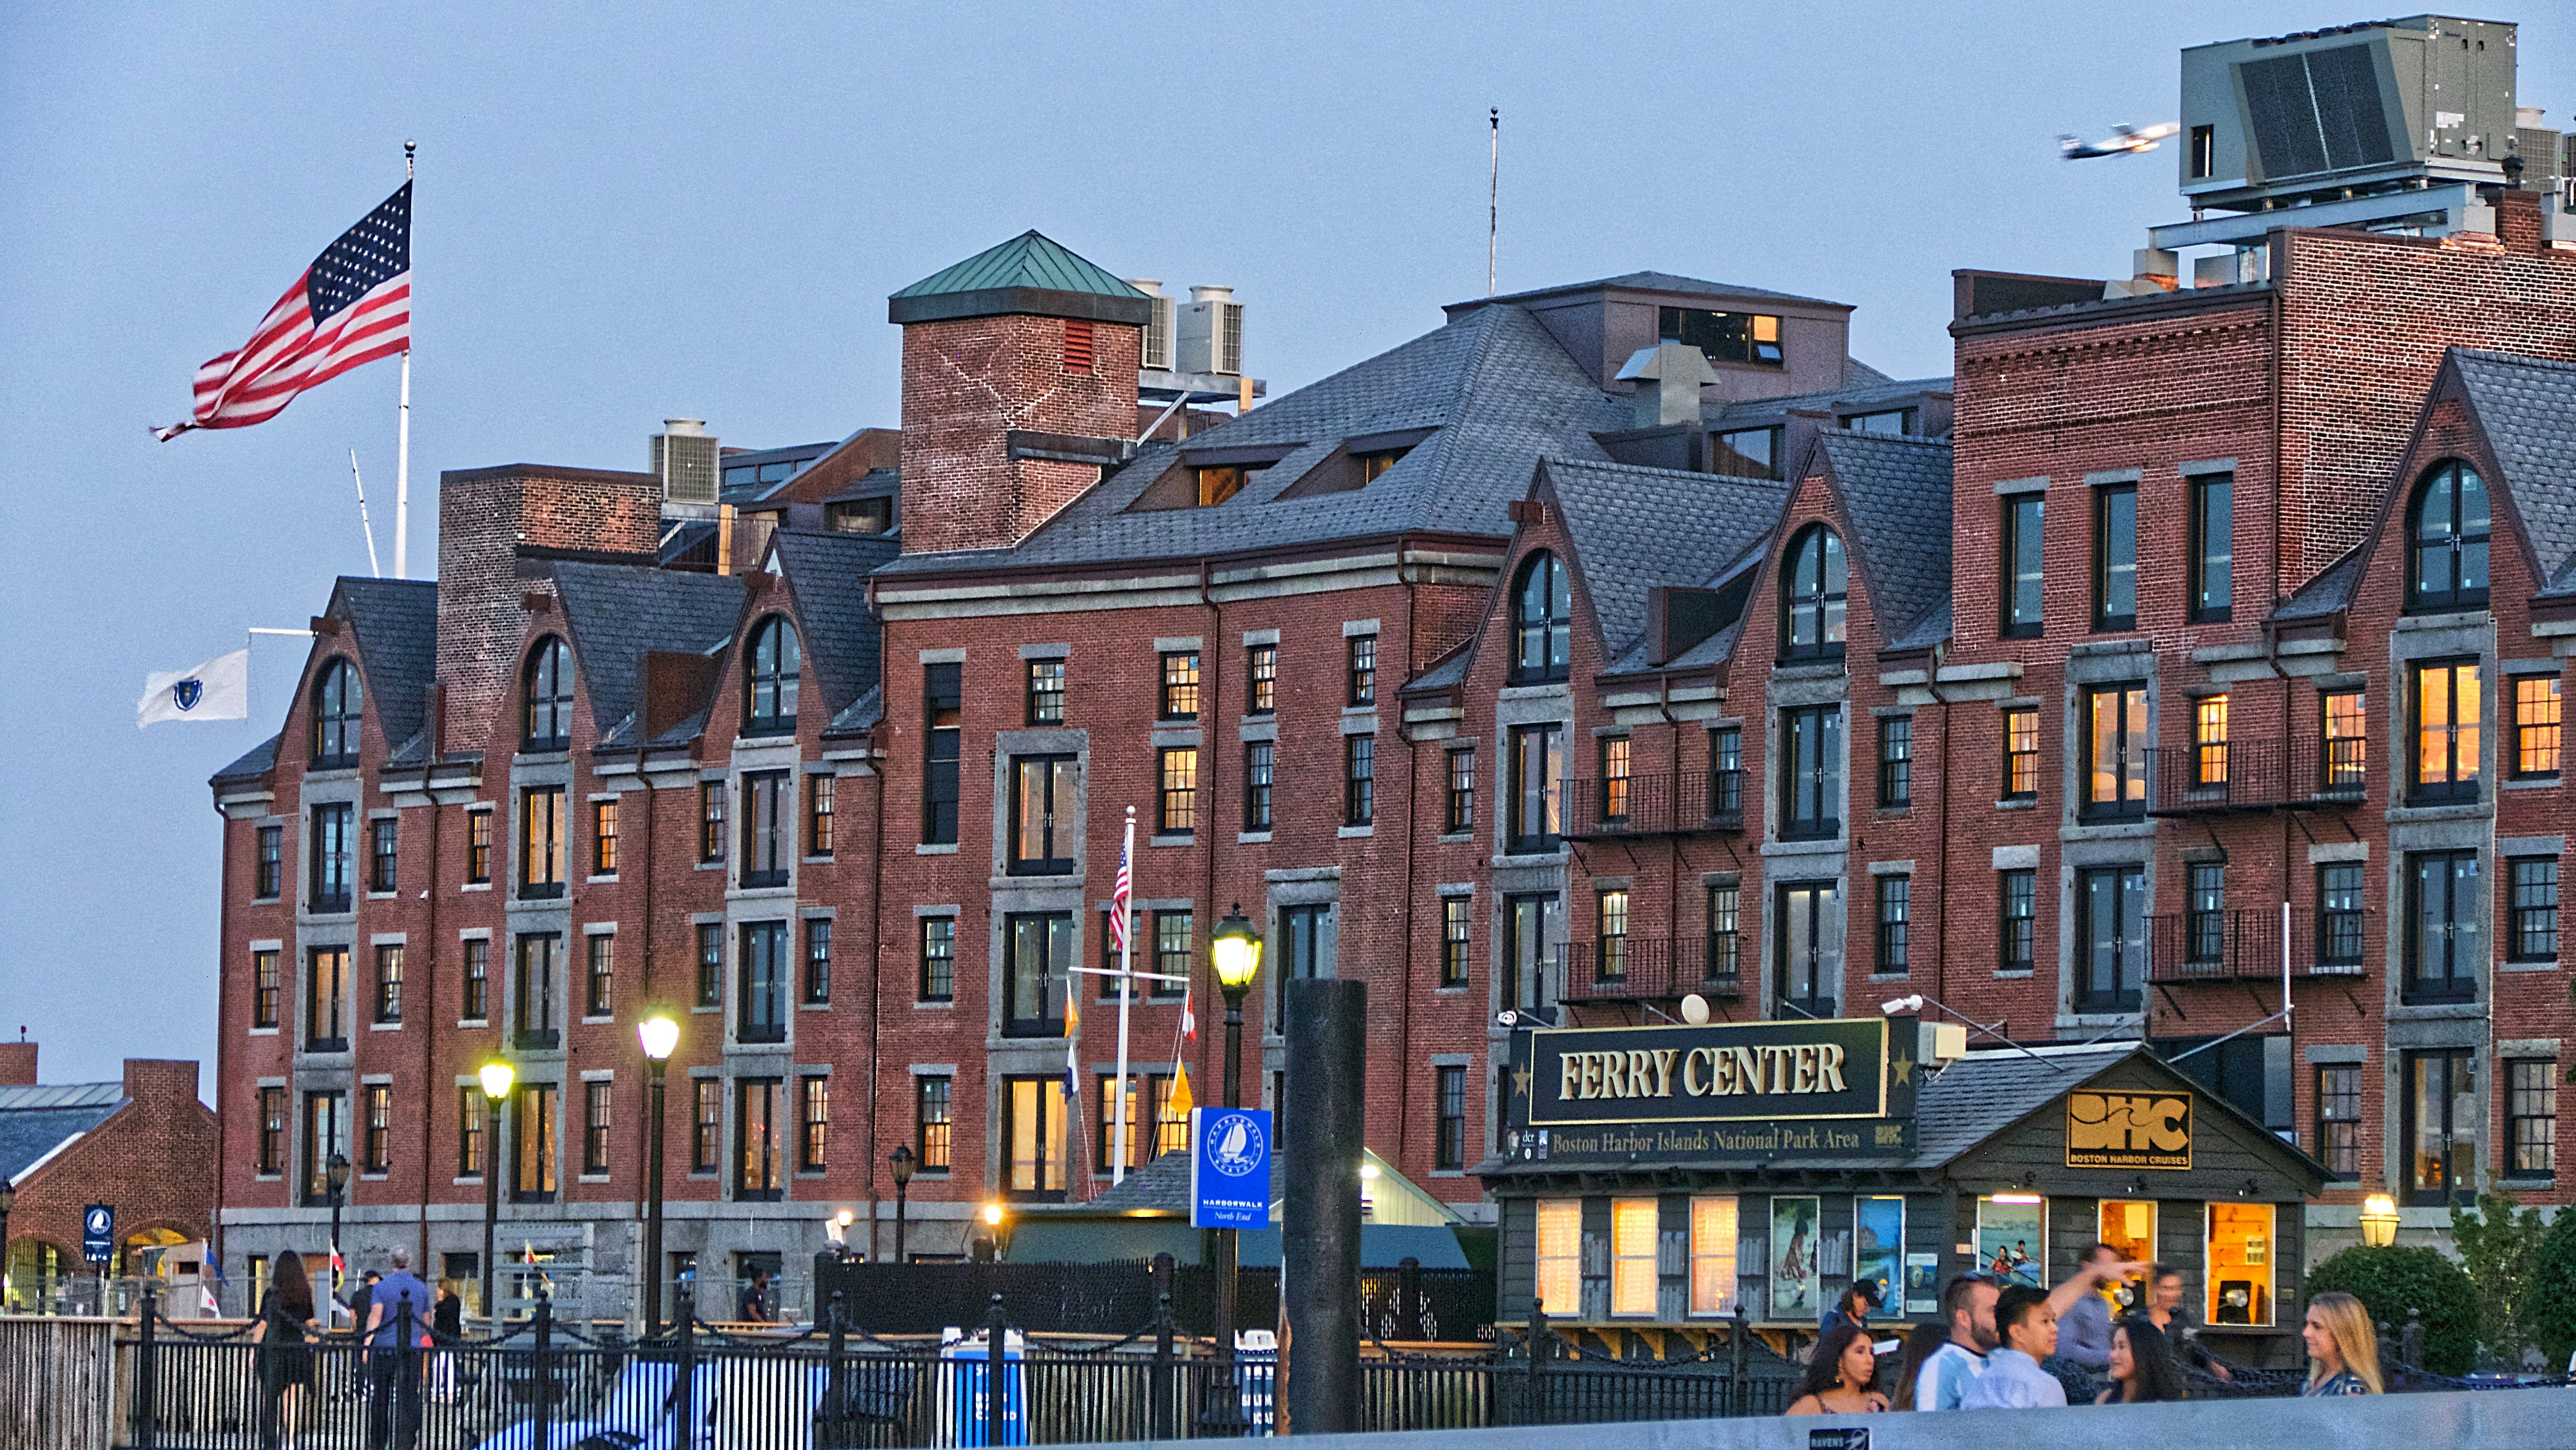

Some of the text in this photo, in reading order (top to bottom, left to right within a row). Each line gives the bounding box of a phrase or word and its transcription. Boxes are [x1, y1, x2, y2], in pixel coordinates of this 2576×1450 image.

[1559, 1044, 1848, 1100] FERRY CENTER
[1522, 1130, 1534, 1143] dcr
[1554, 1127, 1859, 1153] Boston Harbor Islands National Park Area
[2071, 1154, 2188, 1165] BOSTON HARBOR CRUISES
[1203, 1199, 1262, 1208] HARBORWALK
[1215, 1211, 1252, 1221] North End
